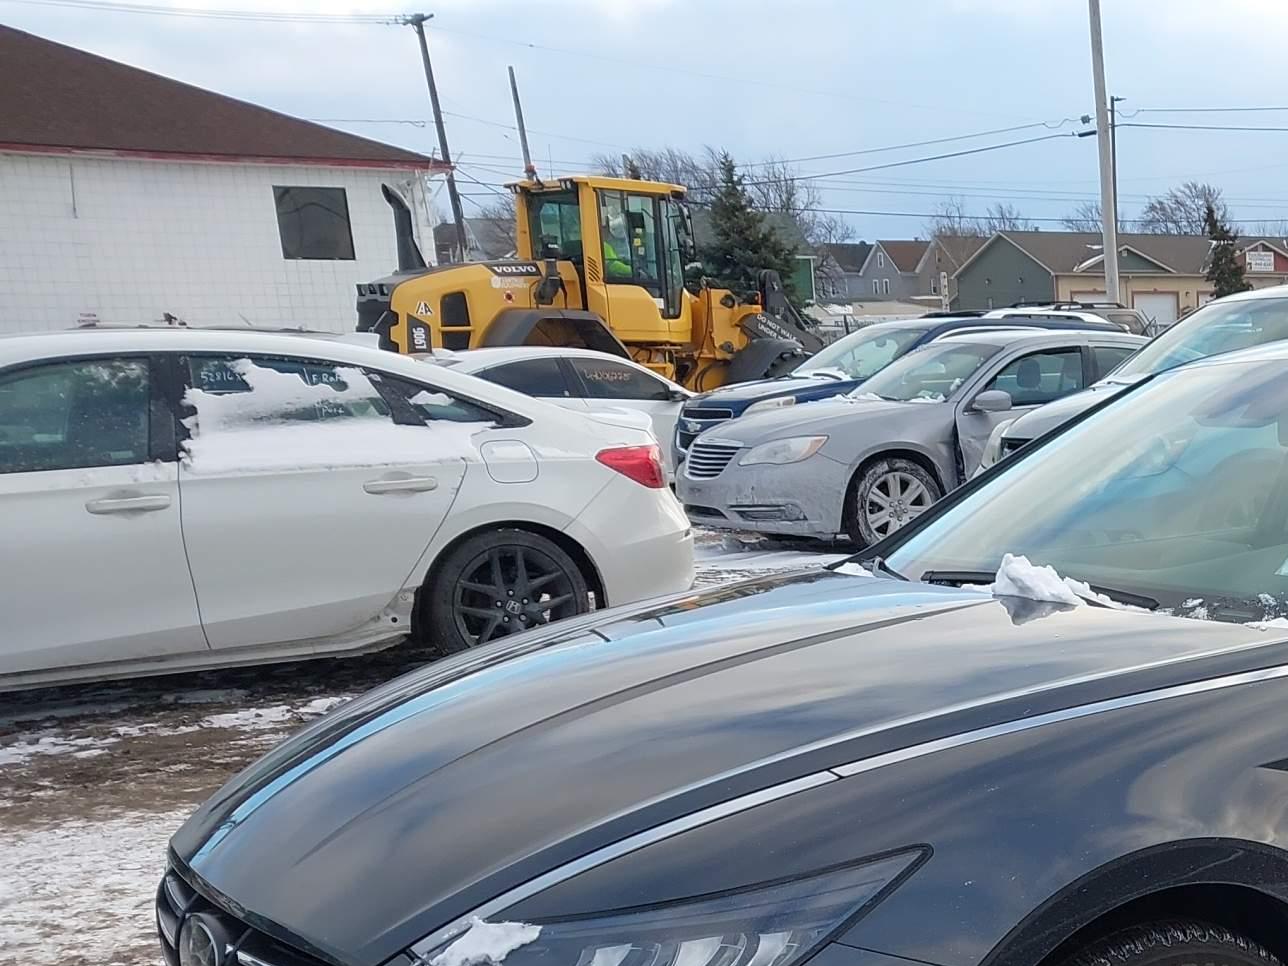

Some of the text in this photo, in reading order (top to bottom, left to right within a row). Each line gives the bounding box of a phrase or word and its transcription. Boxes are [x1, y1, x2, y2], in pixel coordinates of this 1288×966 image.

[492, 265, 536, 273] VOLVO
[757, 314, 767, 323] DO
[767, 319, 780, 332] NOT
[780, 328, 797, 341] WALK
[758, 323, 777, 339] UNDER
